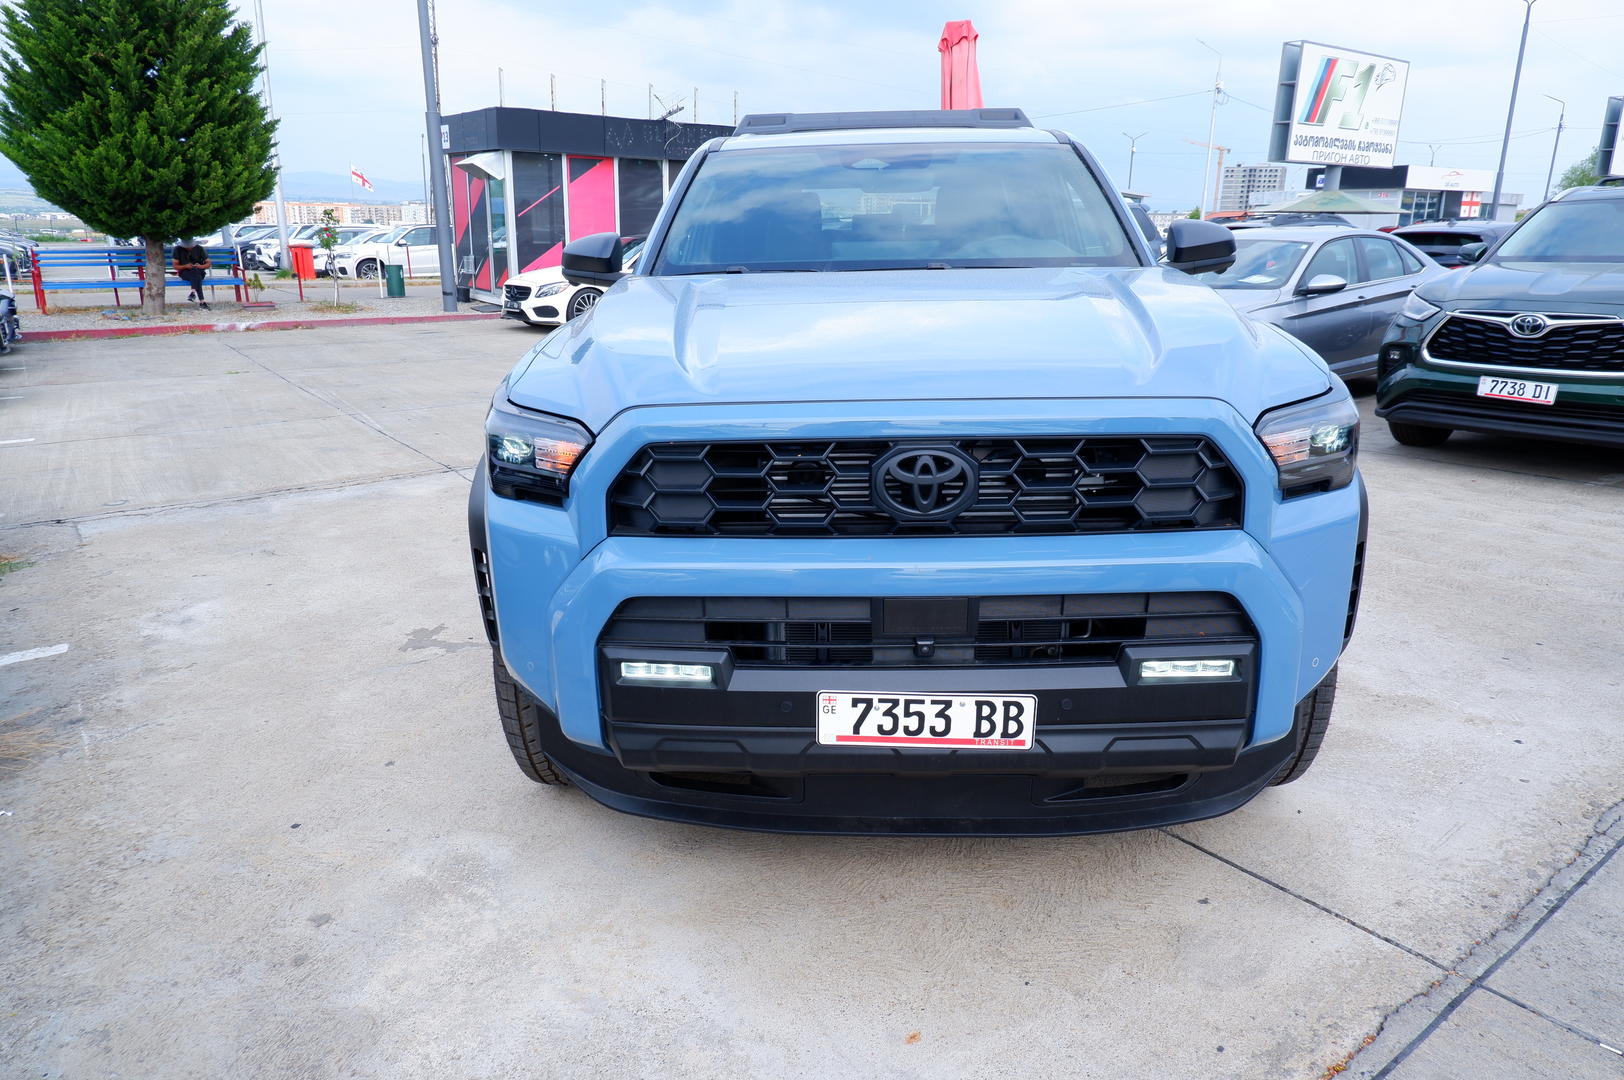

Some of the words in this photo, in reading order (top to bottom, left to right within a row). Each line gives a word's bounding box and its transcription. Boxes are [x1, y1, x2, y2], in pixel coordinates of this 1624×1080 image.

[1312, 150, 1347, 164] ПРИГОН
[1349, 153, 1371, 165] АВТО
[1489, 379, 1527, 397] 7738
[1532, 384, 1551, 400] DI
[822, 705, 837, 714] GE
[851, 697, 953, 737] 7353
[973, 699, 1025, 739] BB
[975, 738, 1015, 746] TRANSIT
